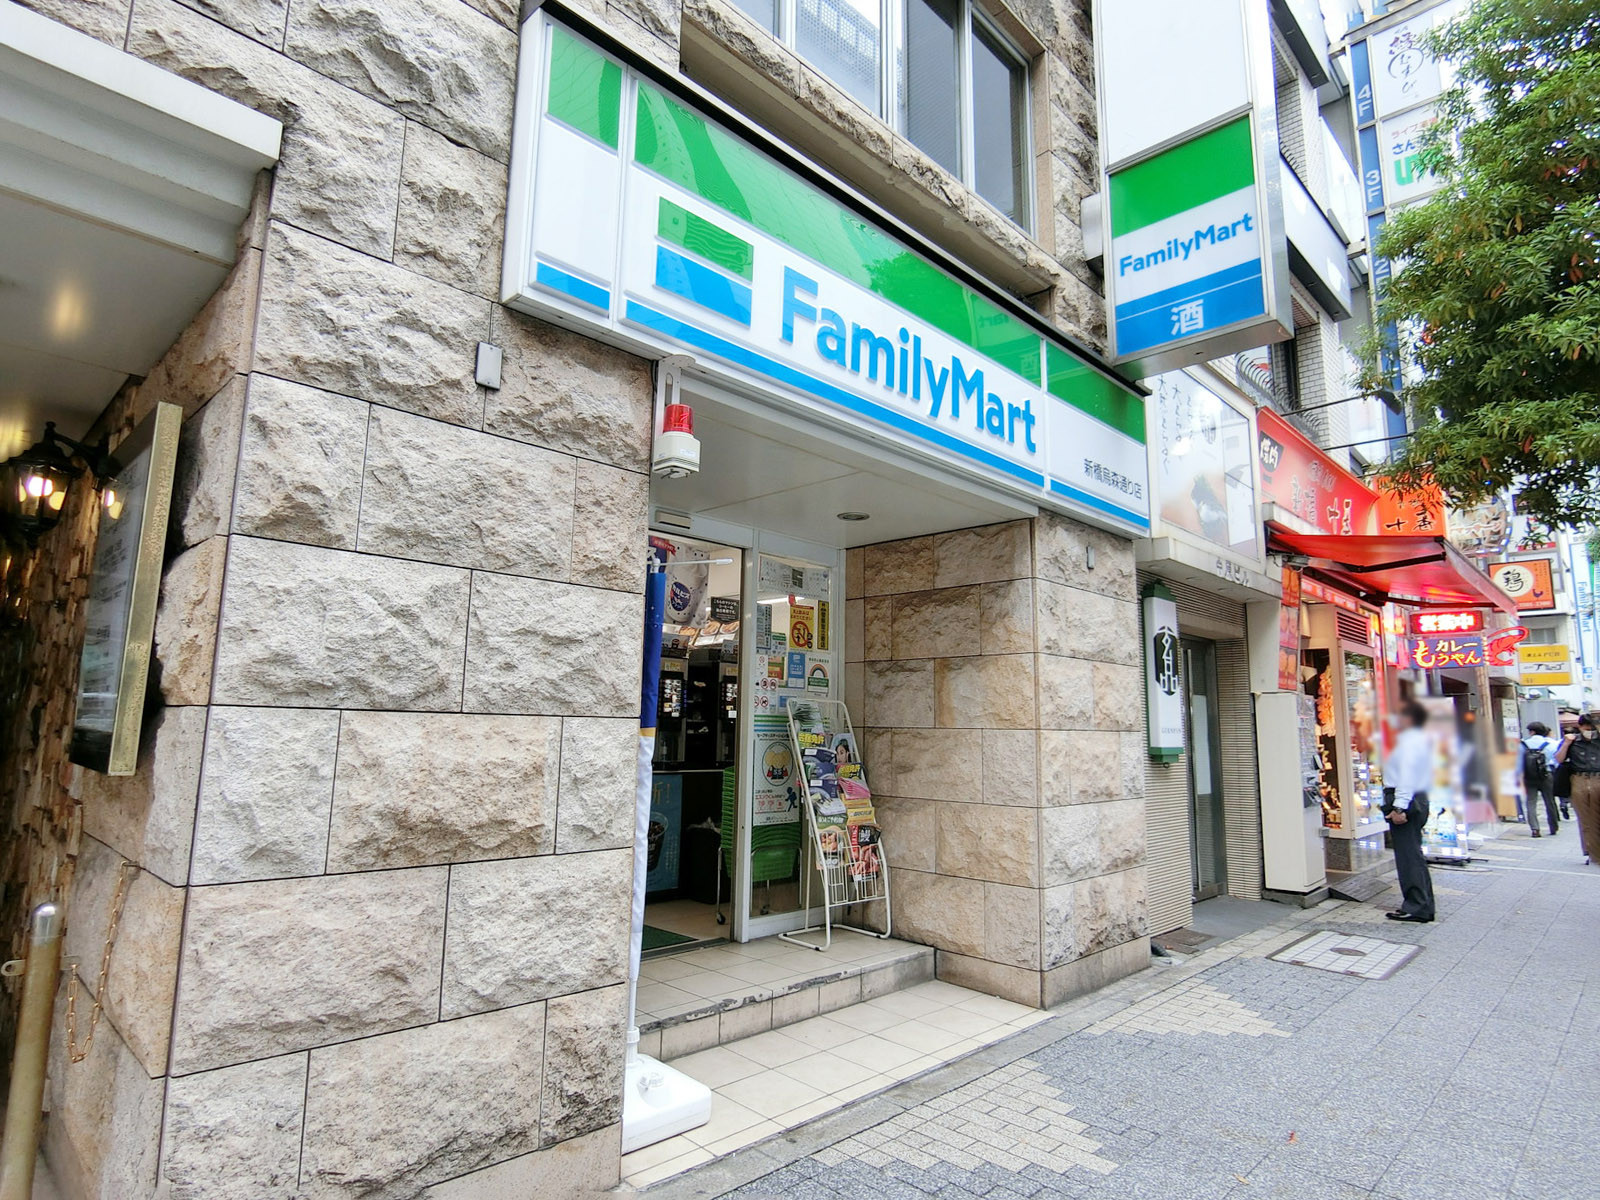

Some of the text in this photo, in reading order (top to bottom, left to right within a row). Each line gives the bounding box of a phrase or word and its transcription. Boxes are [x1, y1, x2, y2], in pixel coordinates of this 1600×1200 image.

[1357, 83, 1372, 118] 4F
[1365, 169, 1381, 203] 3F
[1119, 212, 1253, 277] FamilyMart
[1170, 298, 1204, 336] 酒
[780, 264, 1036, 454] FamilyMart
[1413, 640, 1482, 668] もうやん
[1435, 639, 1478, 652] カレー
